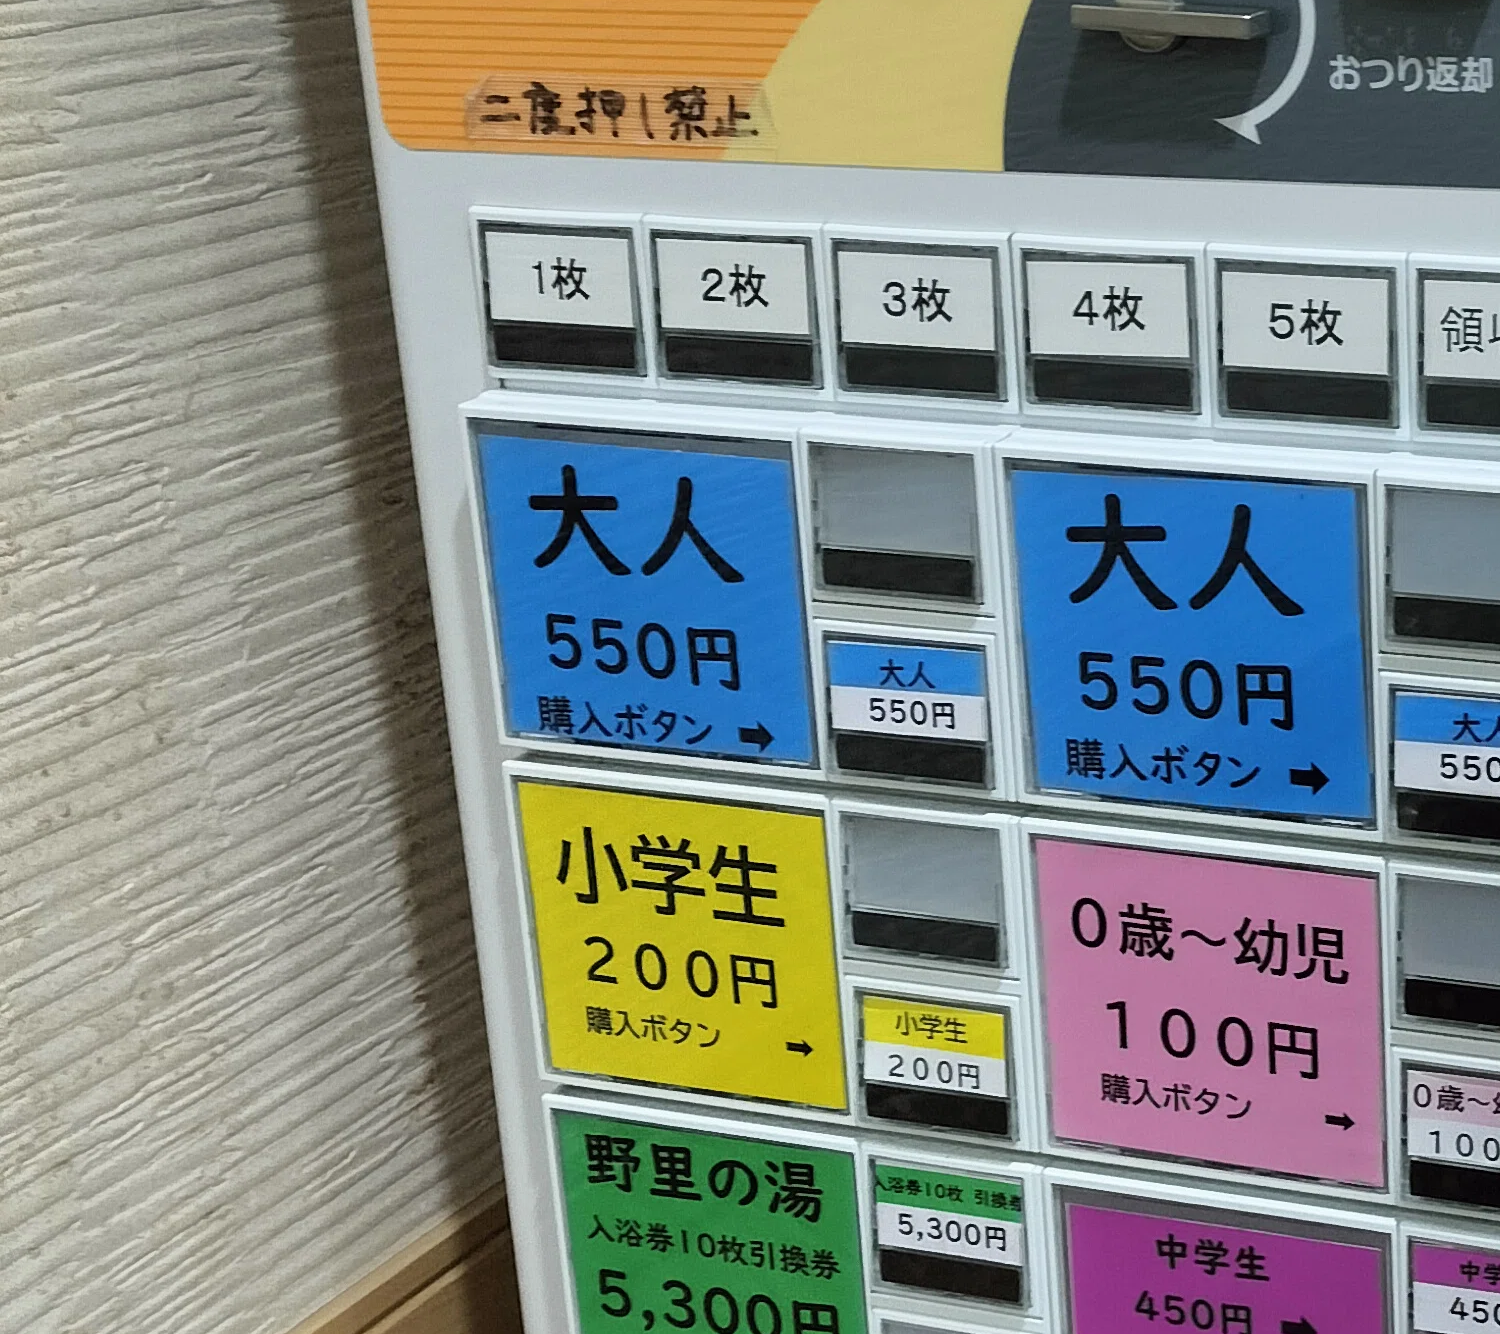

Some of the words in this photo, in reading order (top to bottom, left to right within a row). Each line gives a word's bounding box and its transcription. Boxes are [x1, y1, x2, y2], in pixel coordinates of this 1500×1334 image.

[1329, 54, 1492, 93] おつり返却
[479, 80, 759, 141] 二度押し禁止
[533, 257, 590, 301] 1枚
[701, 264, 769, 308] 2枚
[883, 278, 953, 323] 3枚
[1073, 285, 1146, 331] 4枚
[1269, 299, 1344, 347] 5枚
[528, 464, 745, 583] 大人
[1066, 493, 1304, 617] 大人
[545, 613, 741, 692] 550円
[879, 658, 936, 689] 大人
[869, 697, 956, 730] 550円
[1078, 651, 1294, 731] 550円
[538, 695, 713, 744] 購入ボタン
[1066, 738, 1262, 789] 購入ボタン
[556, 826, 785, 927] 小学生
[584, 936, 778, 1009] 200円
[587, 1006, 720, 1049] 購入ボタン
[895, 1011, 968, 1044] 小学生
[1105, 1000, 1319, 1080] 100円
[888, 1054, 980, 1090] 200円
[1100, 1073, 1252, 1119] 購入ボタン
[585, 1134, 824, 1223] 野里の湯
[587, 1215, 841, 1280] 入浴券10枚引換券
[898, 1213, 1006, 1251] 5,300円
[1156, 1234, 1270, 1282] 中学生
